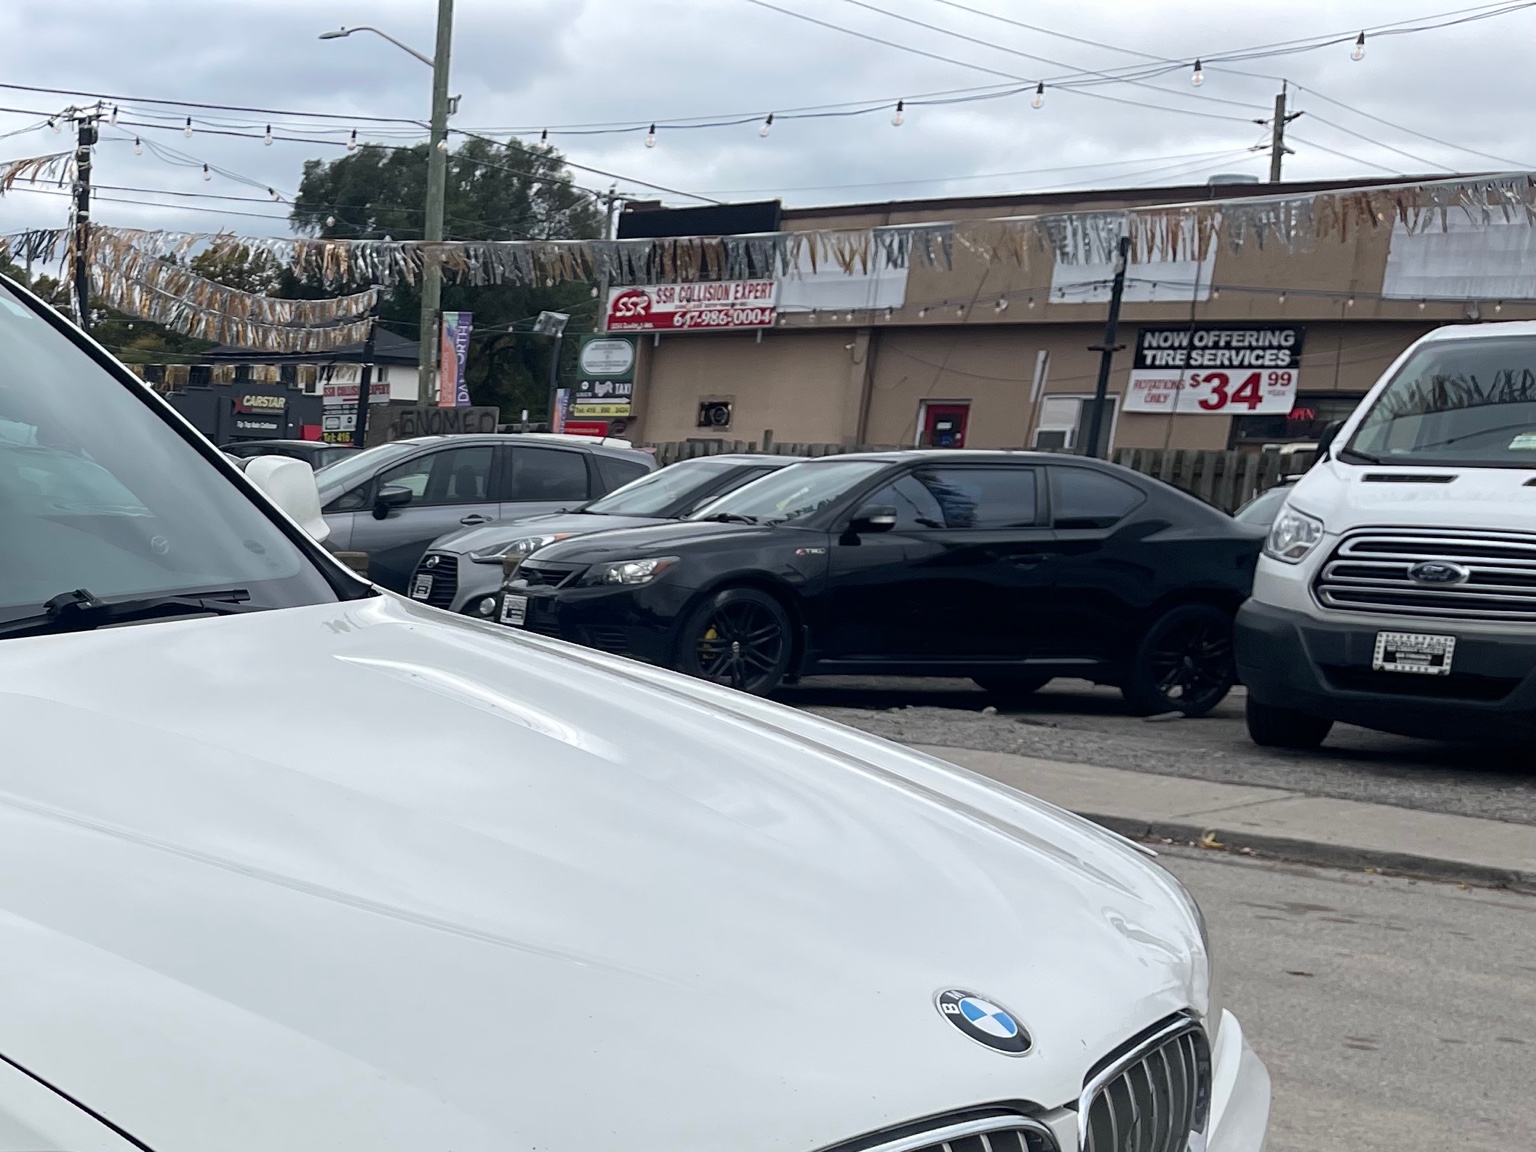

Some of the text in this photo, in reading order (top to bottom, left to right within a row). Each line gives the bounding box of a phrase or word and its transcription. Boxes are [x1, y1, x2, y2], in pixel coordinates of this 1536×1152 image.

[655, 282, 774, 303] SSR COLLISION EXPERT
[615, 296, 649, 317] SSR
[1143, 330, 1295, 348] NOW OFFERING
[1143, 349, 1292, 367] TIRE SERVICES
[1268, 372, 1292, 387] 99
[615, 383, 632, 395] TAXI
[243, 395, 286, 409] CARSTAR
